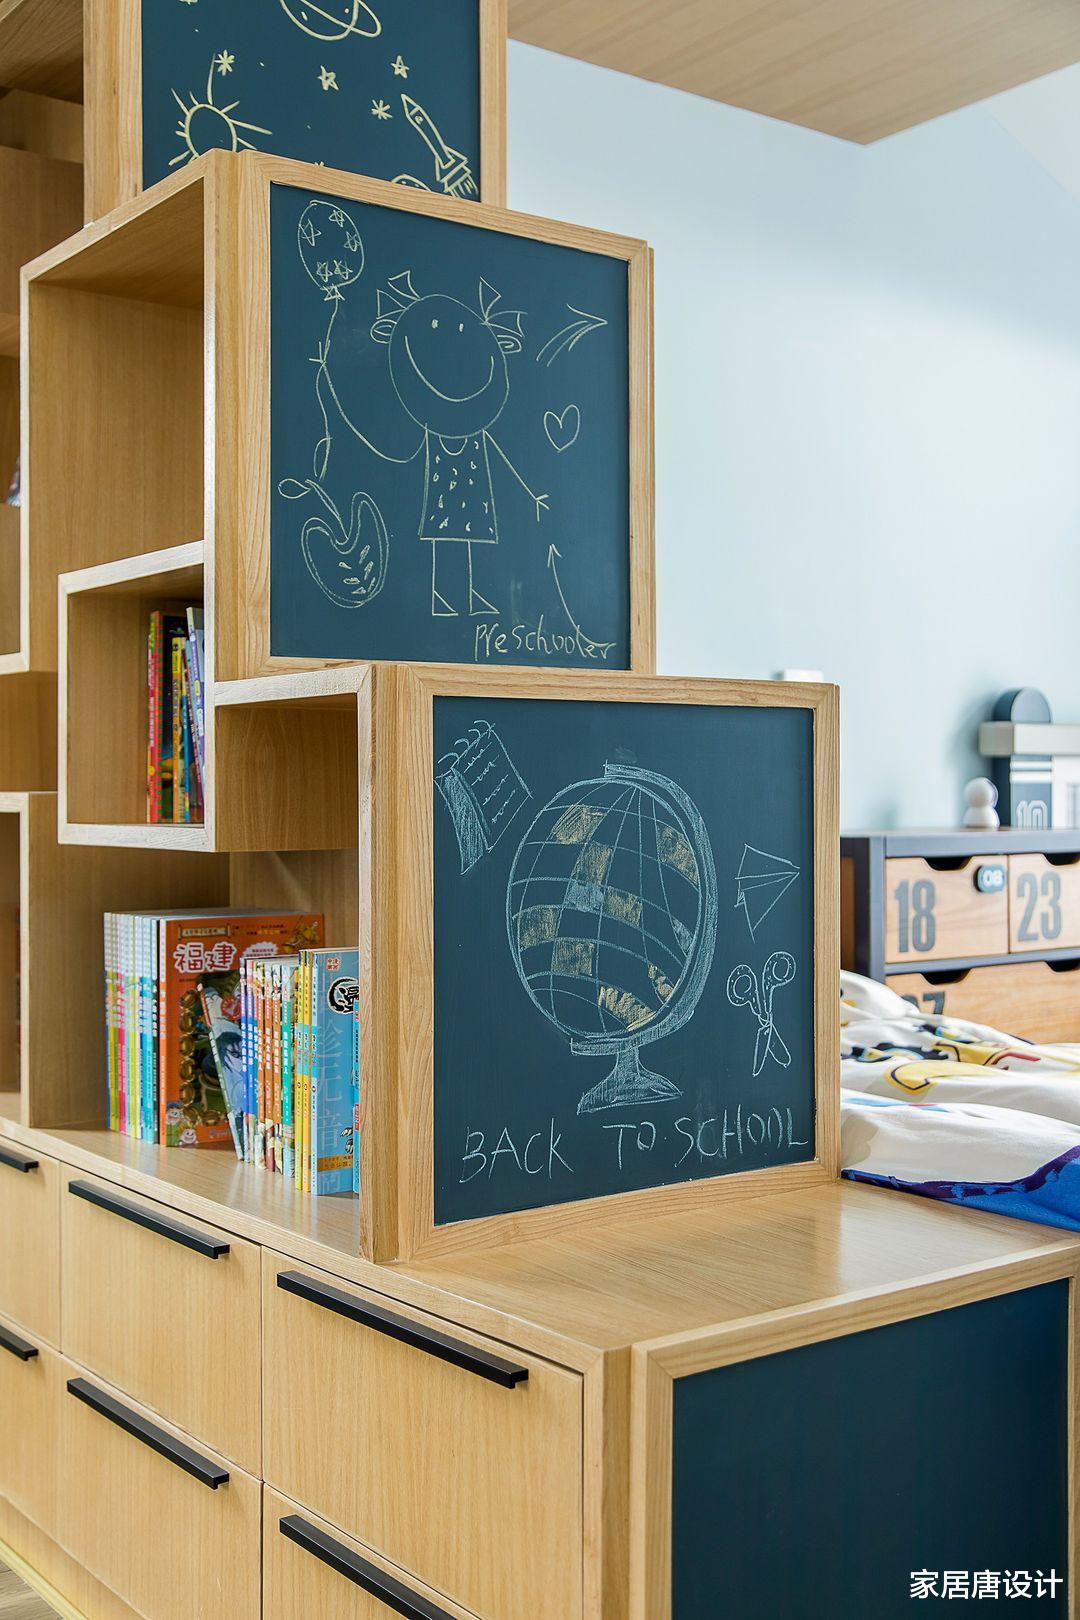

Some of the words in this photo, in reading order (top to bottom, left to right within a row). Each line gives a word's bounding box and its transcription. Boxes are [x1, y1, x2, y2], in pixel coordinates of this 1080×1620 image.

[894, 879, 936, 953] 18
[1016, 872, 1062, 942] 23
[174, 942, 235, 972] 福建
[459, 1118, 574, 1183] BACK
[602, 1121, 657, 1170] TO
